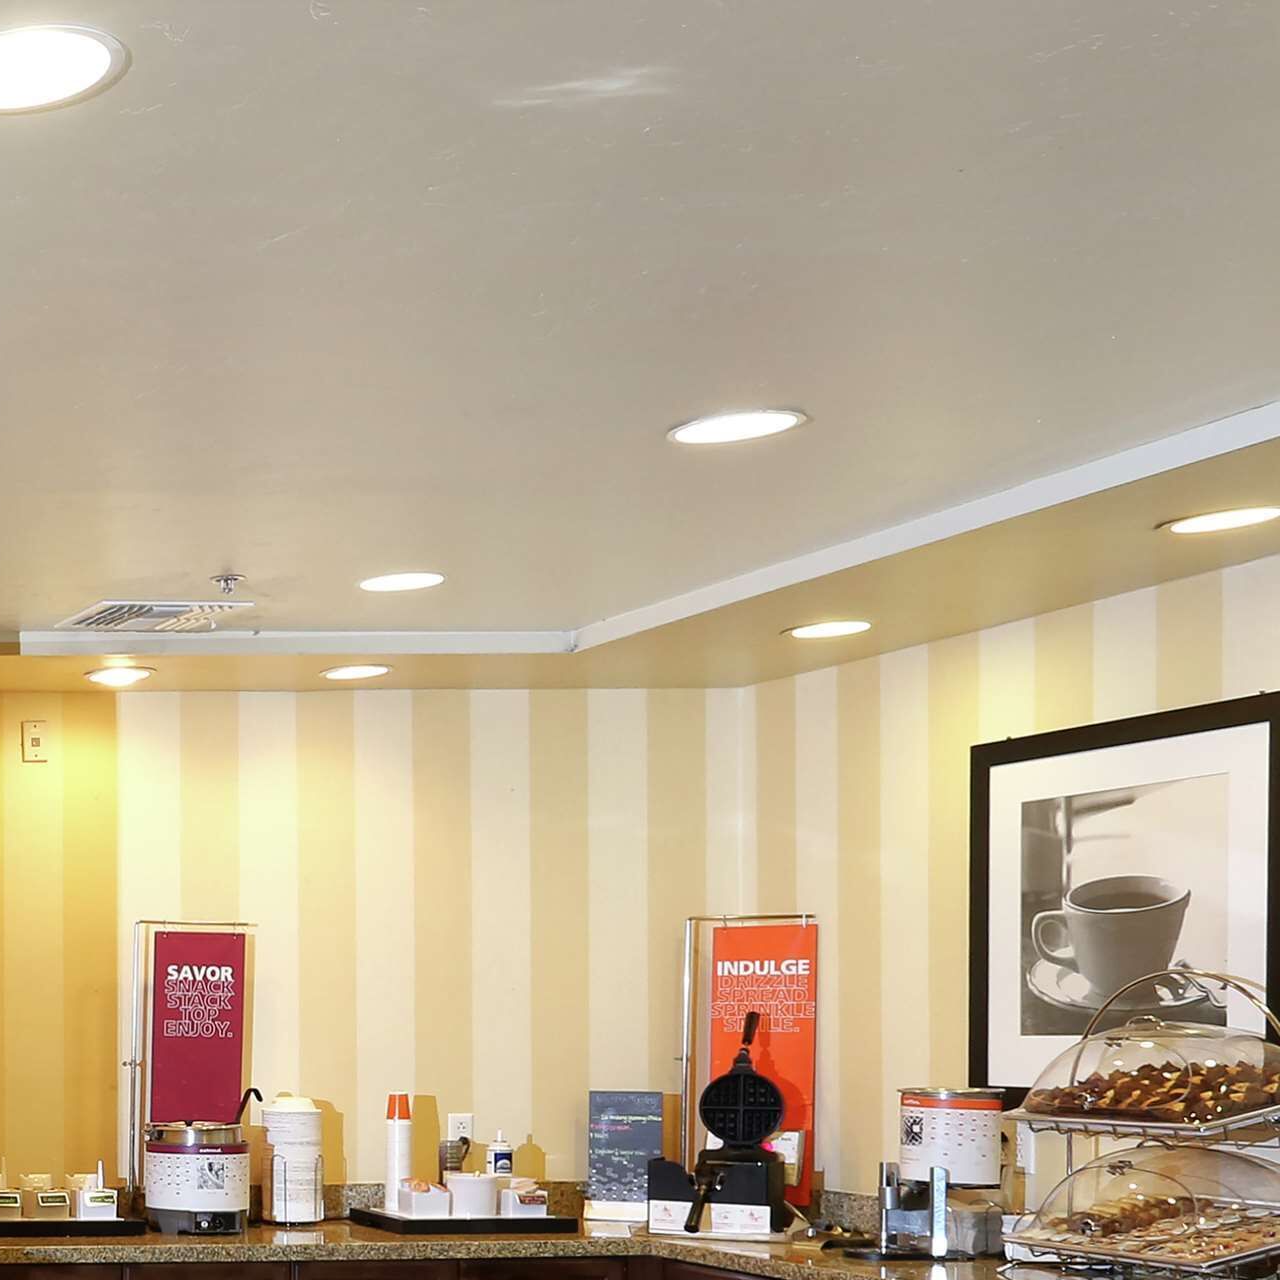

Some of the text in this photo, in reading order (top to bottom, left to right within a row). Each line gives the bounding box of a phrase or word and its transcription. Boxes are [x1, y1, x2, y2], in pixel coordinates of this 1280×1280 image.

[167, 964, 233, 981] SAVOR
[717, 959, 810, 976] INDULGE
[164, 979, 235, 996] SNACK
[719, 975, 808, 990] DRIZZLE
[167, 991, 232, 1010] STACK
[718, 987, 809, 1003] SPREAD
[180, 1005, 219, 1022] TOP
[711, 1001, 816, 1018] SPRINKLE
[163, 1019, 233, 1038] ENJOY.
